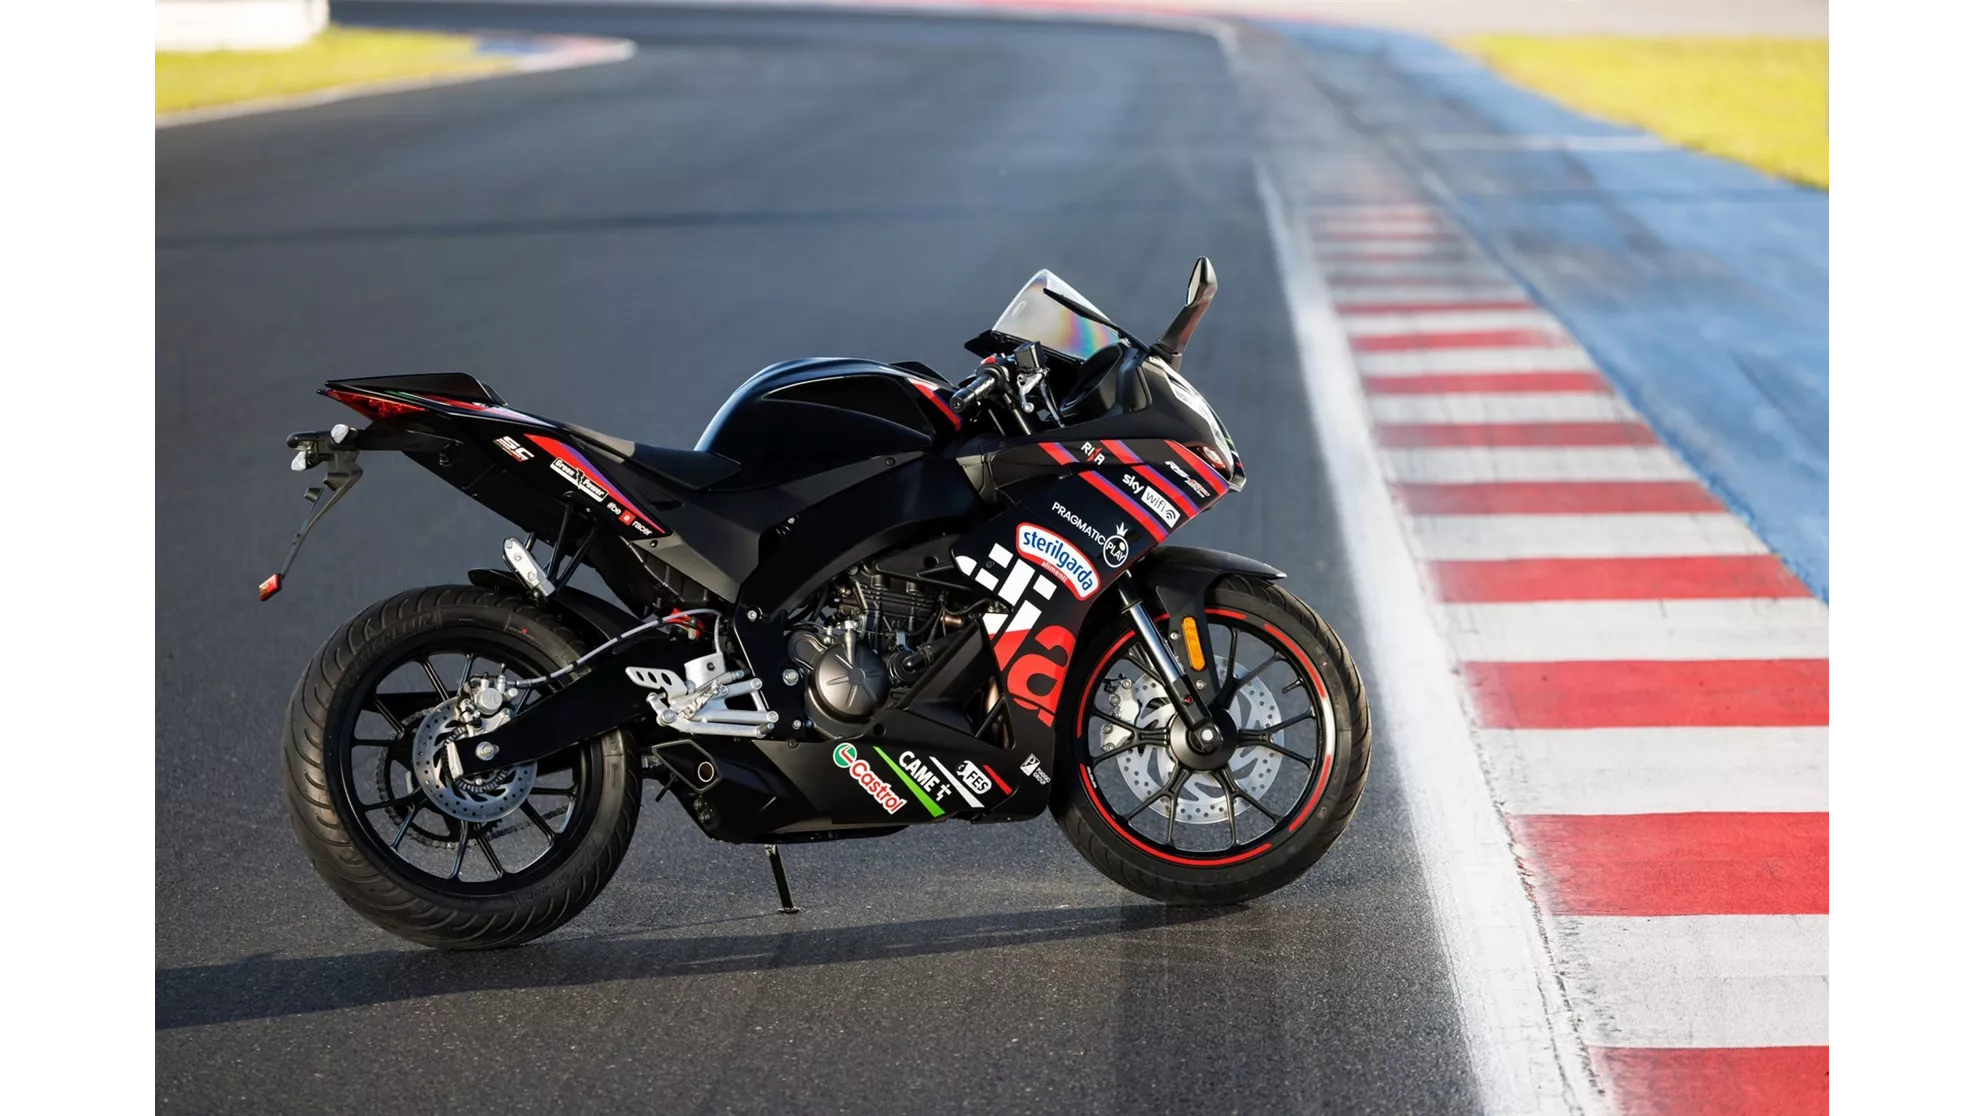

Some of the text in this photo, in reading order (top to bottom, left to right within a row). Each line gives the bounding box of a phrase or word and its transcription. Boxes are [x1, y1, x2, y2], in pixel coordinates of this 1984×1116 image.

[502, 435, 535, 461] SC
[554, 459, 605, 496] Green Power
[1122, 473, 1168, 512] sky wifi
[606, 501, 622, 515] #be
[632, 520, 653, 536] racer
[1051, 501, 1126, 562] PRAGMATIC PLAY
[1023, 531, 1093, 591] sterilgarda
[1041, 560, 1067, 583] alimenti
[851, 761, 905, 813] Castrol
[899, 751, 940, 792] CAME
[966, 770, 989, 791] FES
